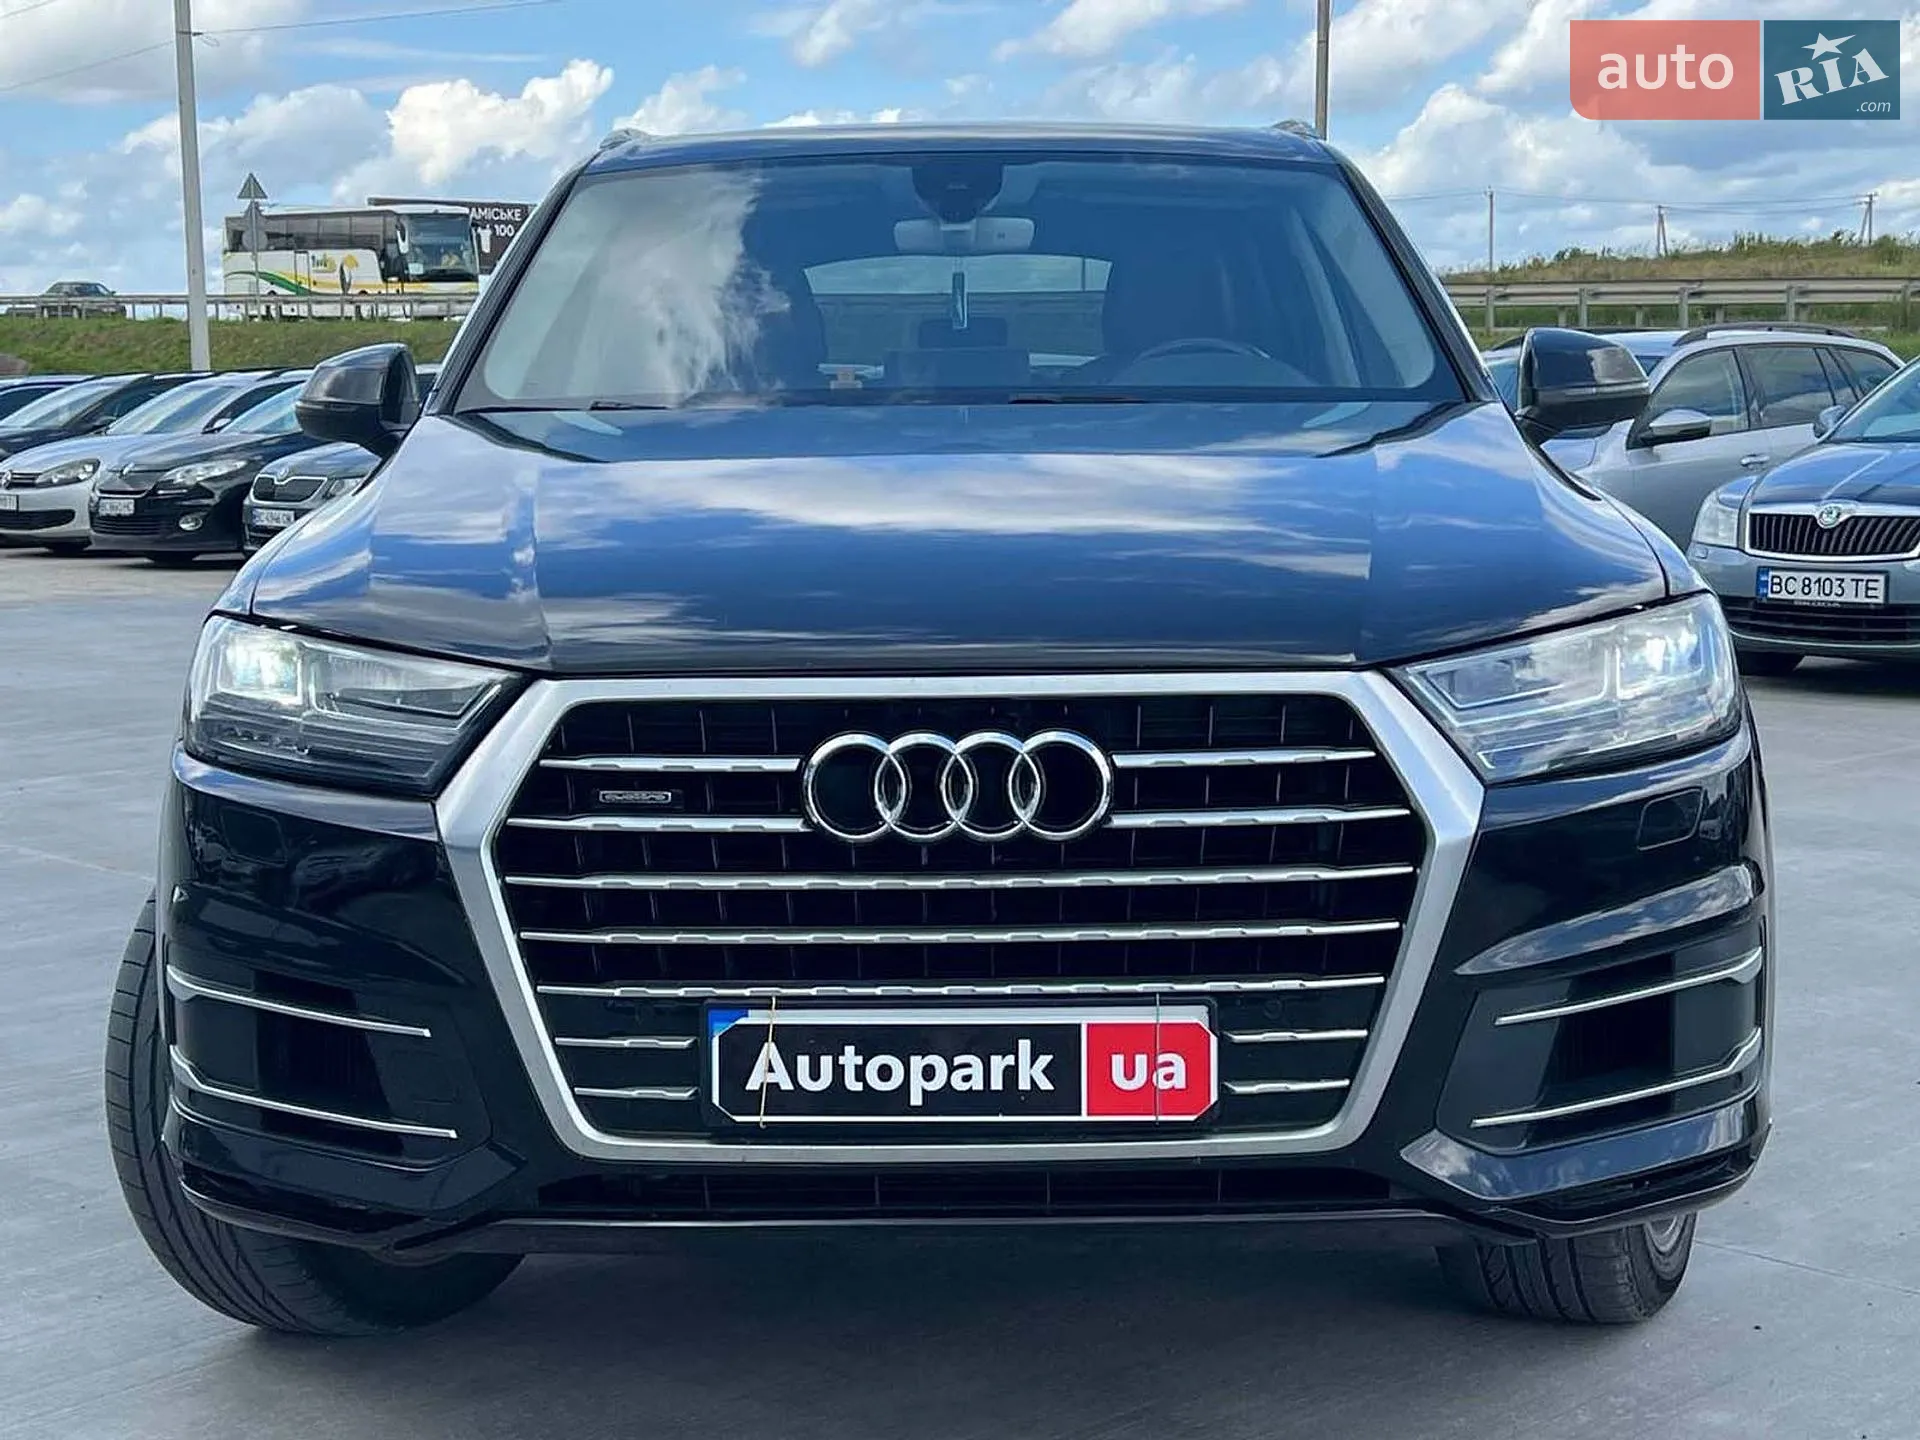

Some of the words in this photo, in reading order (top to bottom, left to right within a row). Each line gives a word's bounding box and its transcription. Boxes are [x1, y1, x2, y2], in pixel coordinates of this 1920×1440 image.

[1770, 575, 1797, 595] BC
[1801, 576, 1845, 597] 8103
[1850, 578, 1880, 599] TE
[745, 1038, 1055, 1106] Autopark
[1111, 1052, 1188, 1091] ua
